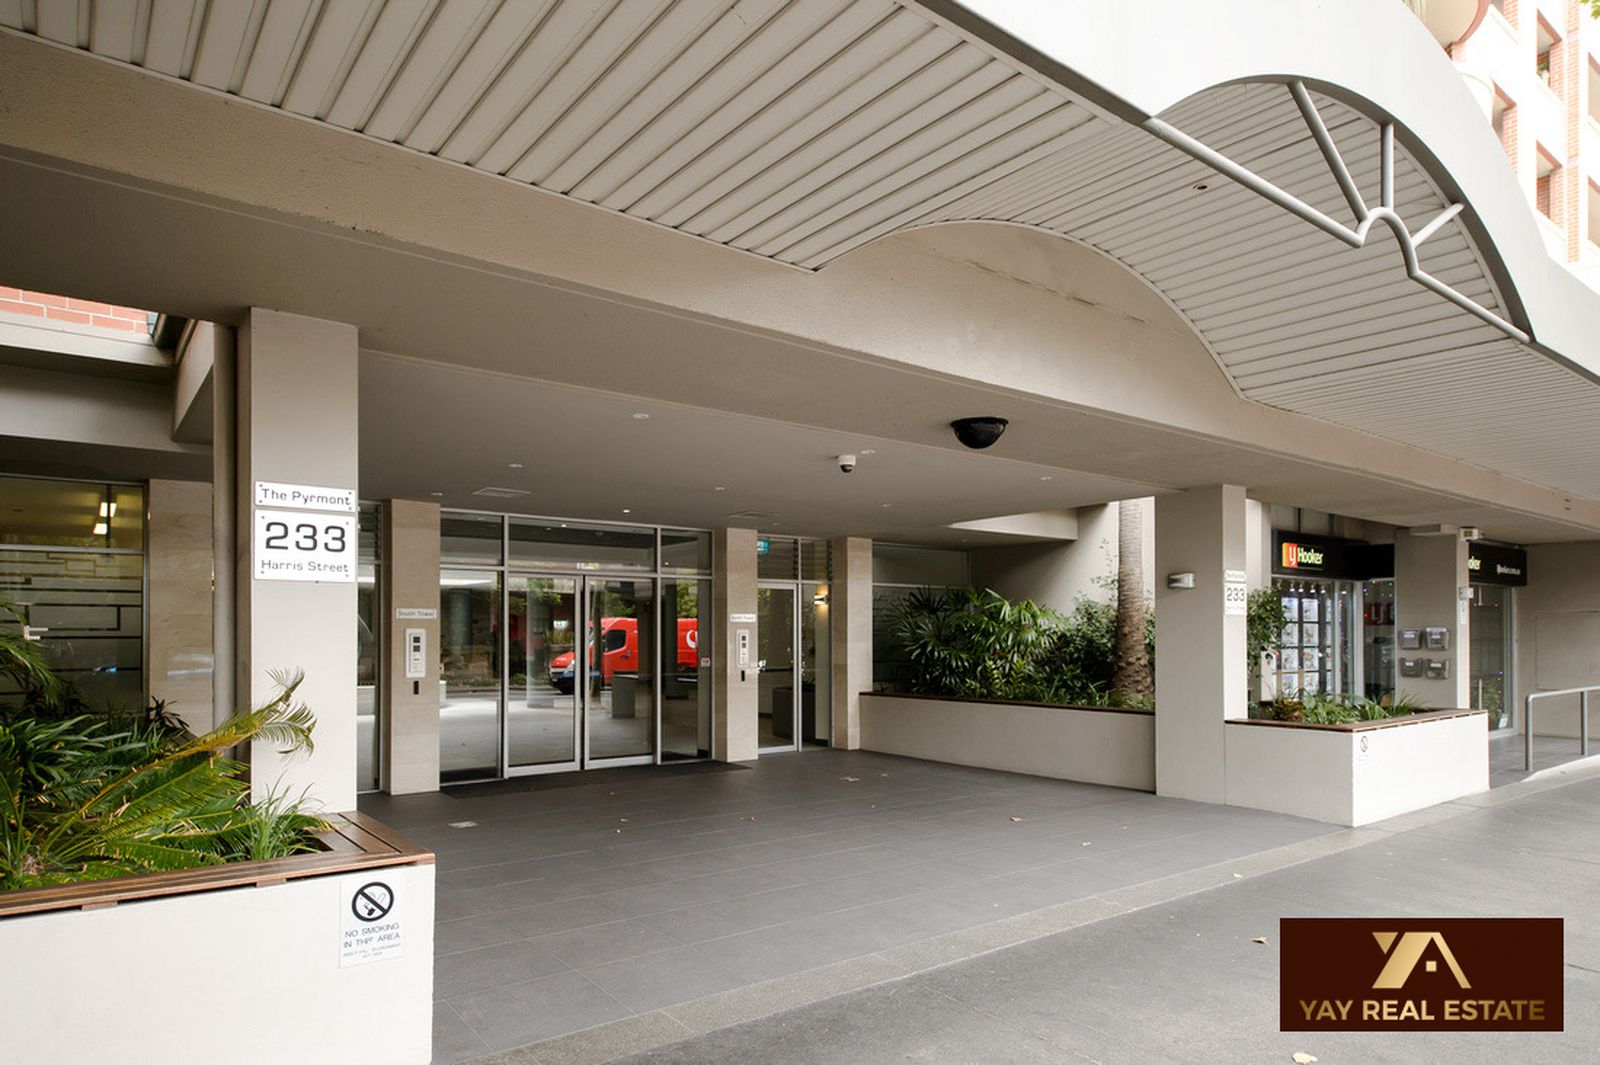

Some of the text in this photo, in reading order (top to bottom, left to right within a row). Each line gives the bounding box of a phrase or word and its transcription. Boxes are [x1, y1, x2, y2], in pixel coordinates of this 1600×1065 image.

[261, 488, 351, 505] The Pyrmont
[265, 522, 346, 553] 233
[1297, 547, 1323, 565] Hooker
[261, 560, 348, 573] Harris Street
[1226, 587, 1245, 602] 233
[345, 922, 400, 938] NO SMOKING
